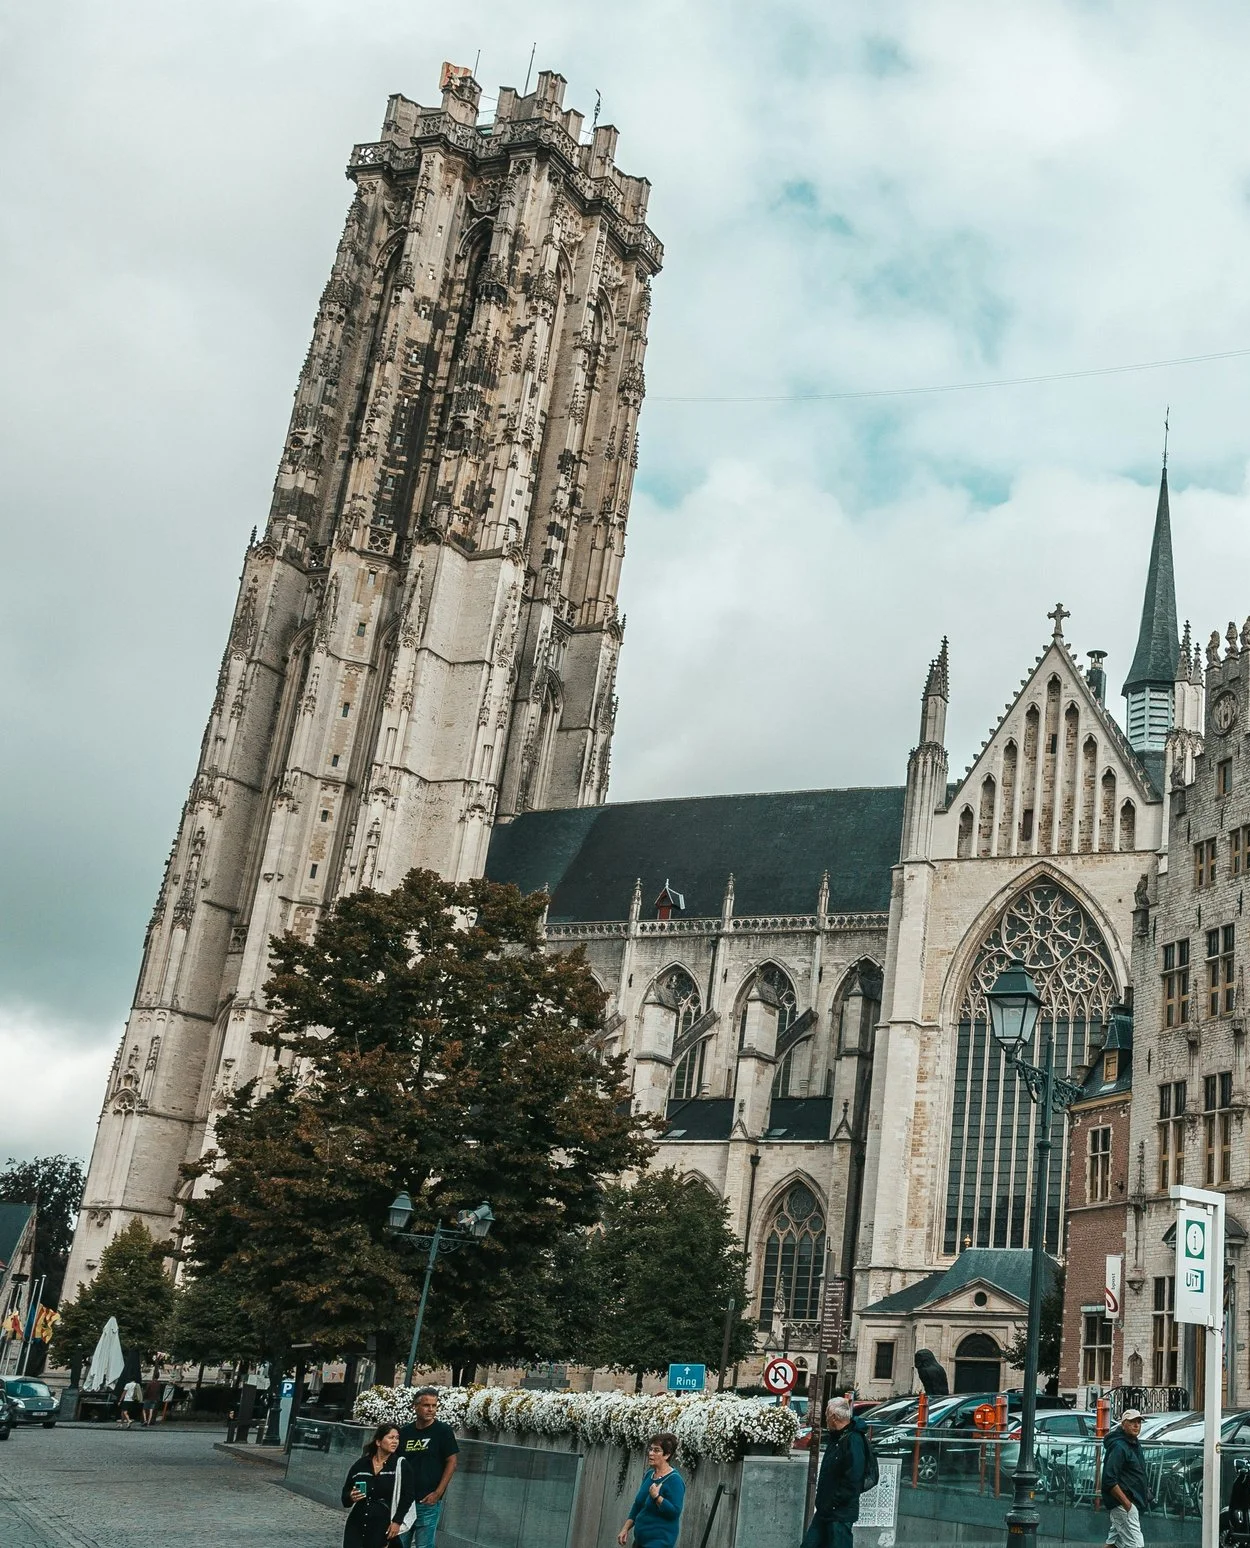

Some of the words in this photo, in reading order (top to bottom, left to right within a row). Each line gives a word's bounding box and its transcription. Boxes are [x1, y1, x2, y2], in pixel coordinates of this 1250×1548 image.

[282, 1382, 293, 1394] P
[676, 1376, 697, 1388] Ring
[406, 1438, 431, 1449] EA7
